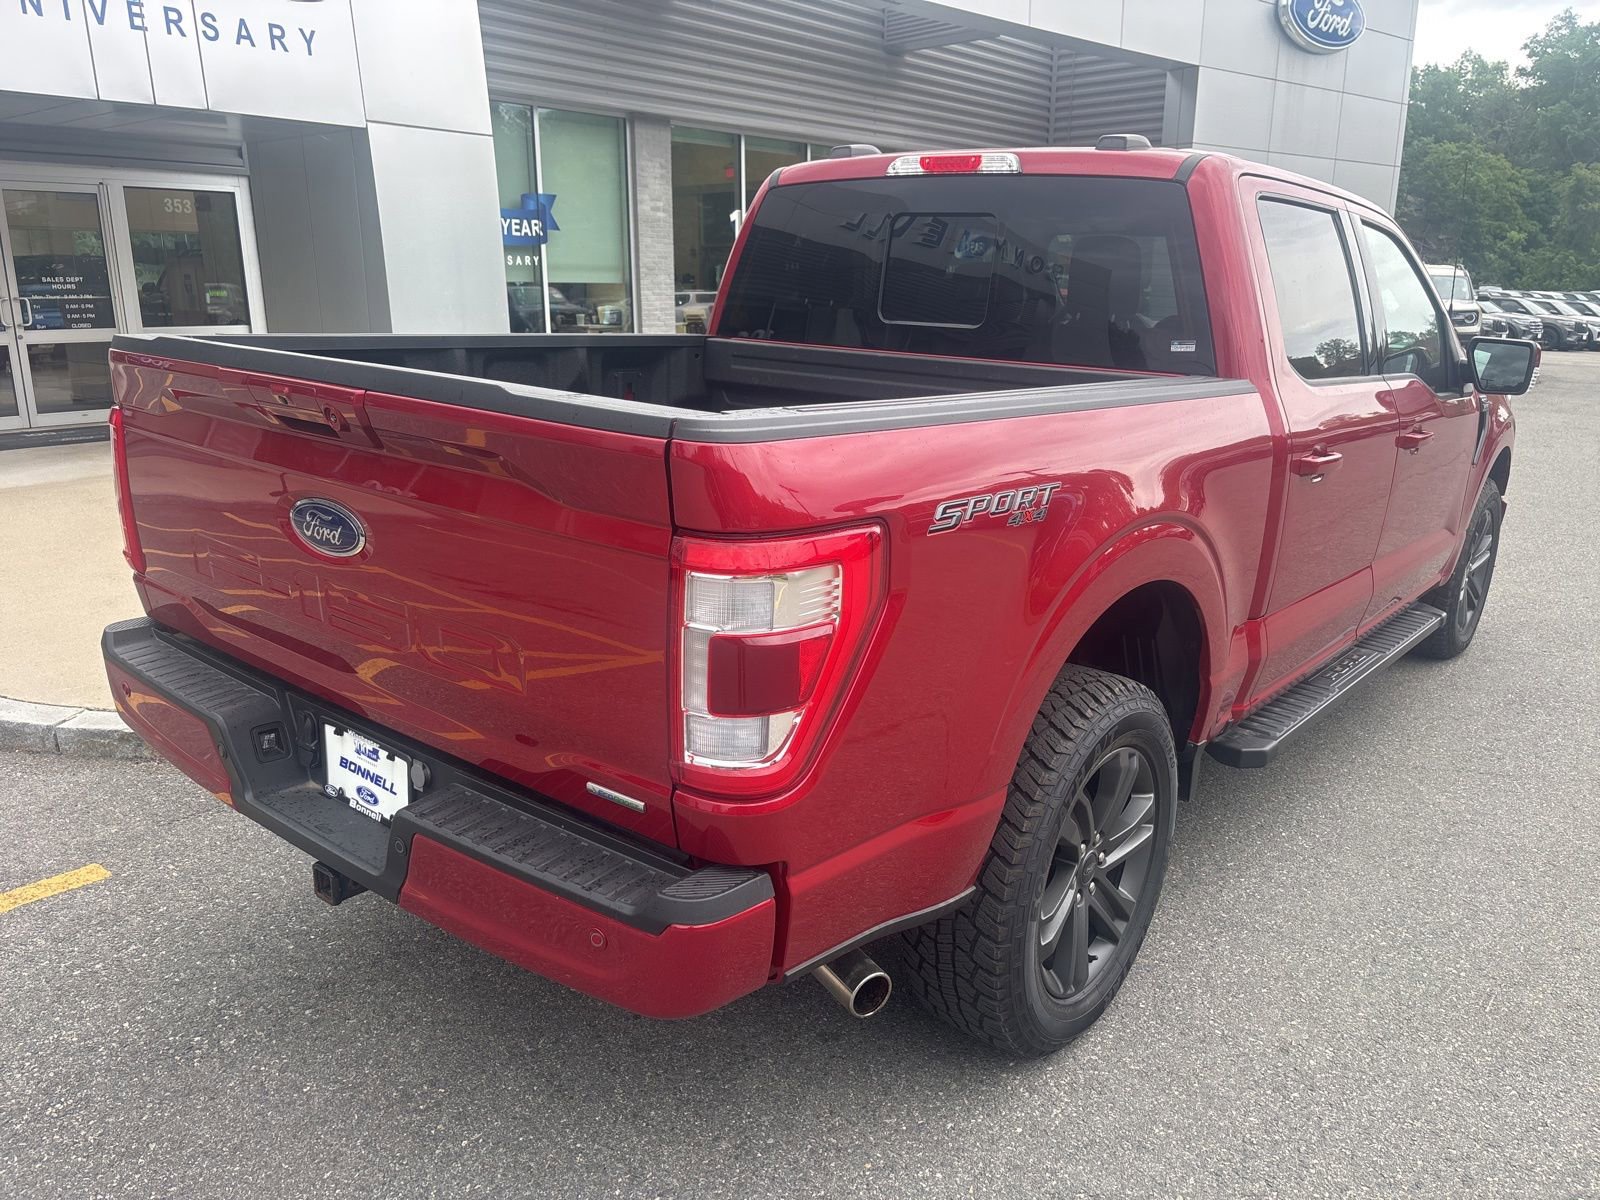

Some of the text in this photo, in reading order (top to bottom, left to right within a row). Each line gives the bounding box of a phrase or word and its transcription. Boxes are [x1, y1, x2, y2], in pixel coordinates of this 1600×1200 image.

[1306, 0, 1354, 37] Ford
[164, 198, 192, 214] 353
[500, 217, 544, 236] YEAR
[303, 509, 342, 546] Ford
[926, 481, 1063, 537] SPORT
[338, 755, 398, 796] BONNELL
[349, 796, 382, 823] Bonnell
